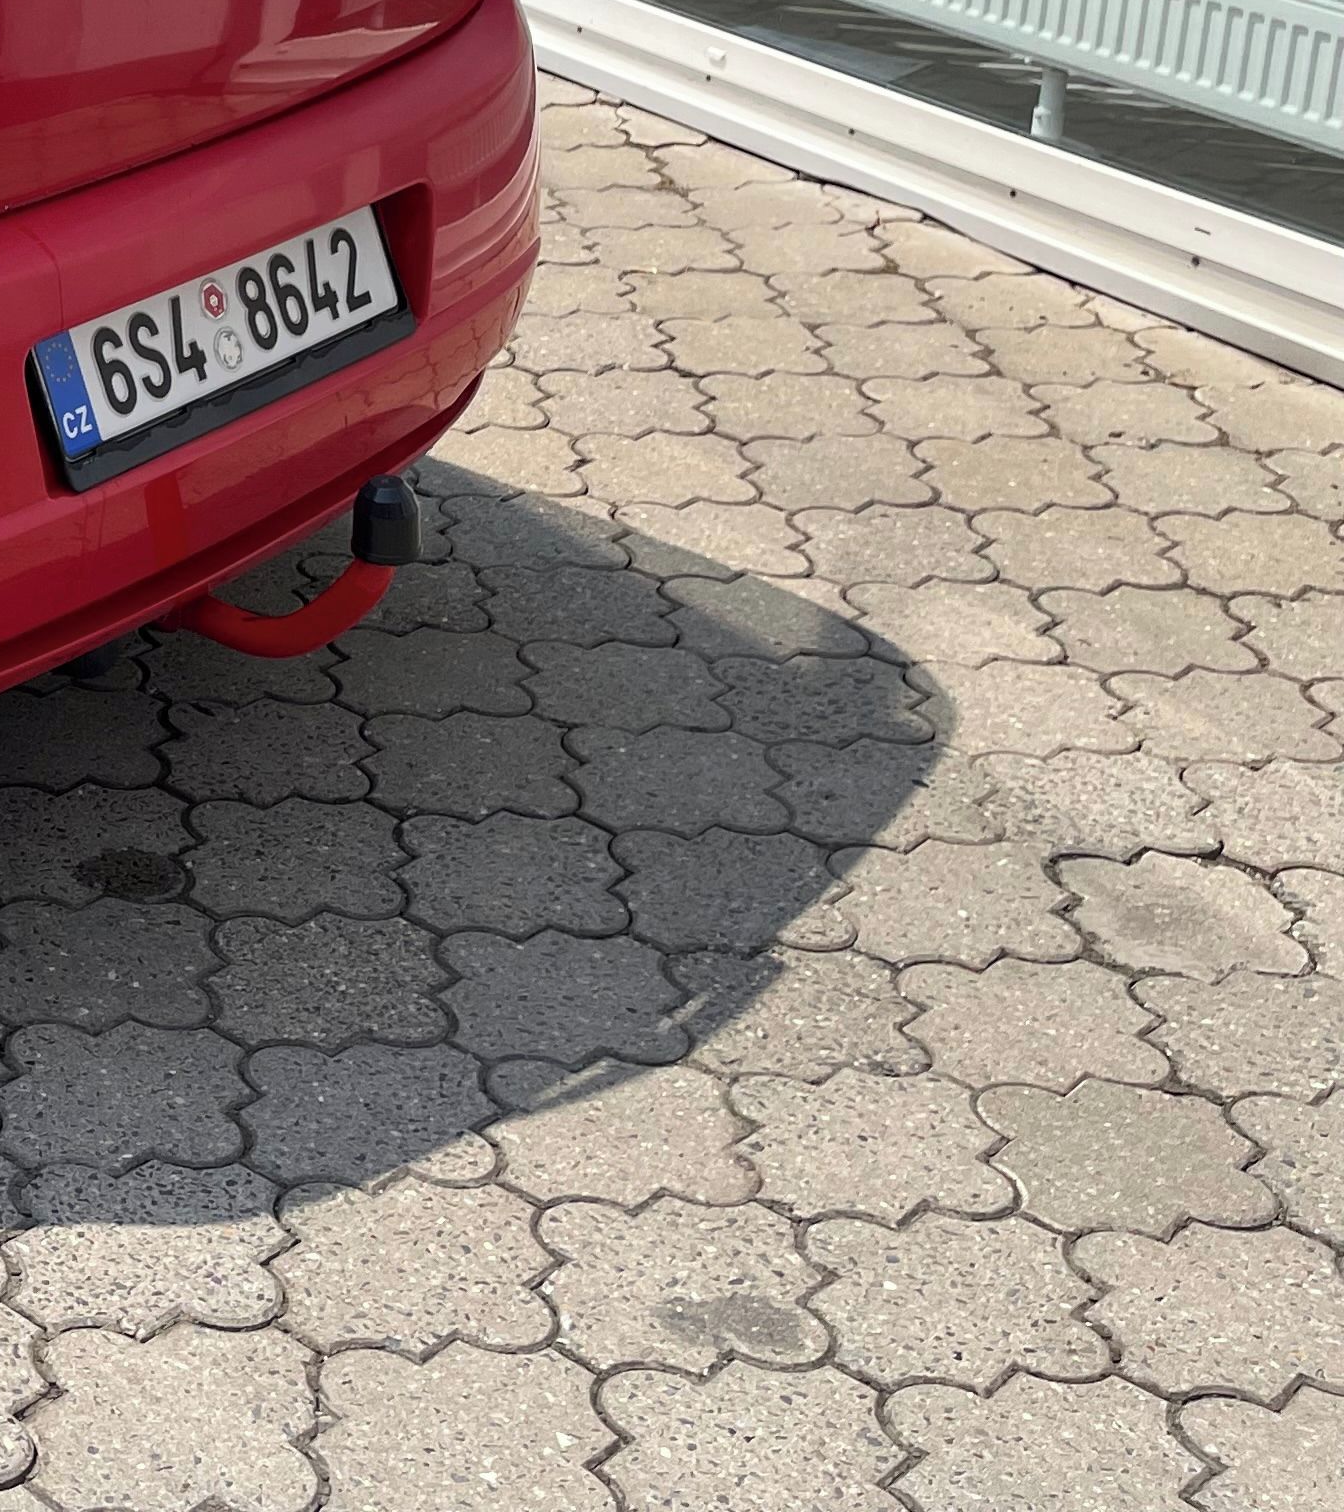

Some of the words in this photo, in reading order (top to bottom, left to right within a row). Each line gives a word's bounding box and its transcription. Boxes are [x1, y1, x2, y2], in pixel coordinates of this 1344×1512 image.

[93, 294, 208, 416] 6S4
[237, 227, 373, 352] 8642
[63, 405, 93, 439] CZ
